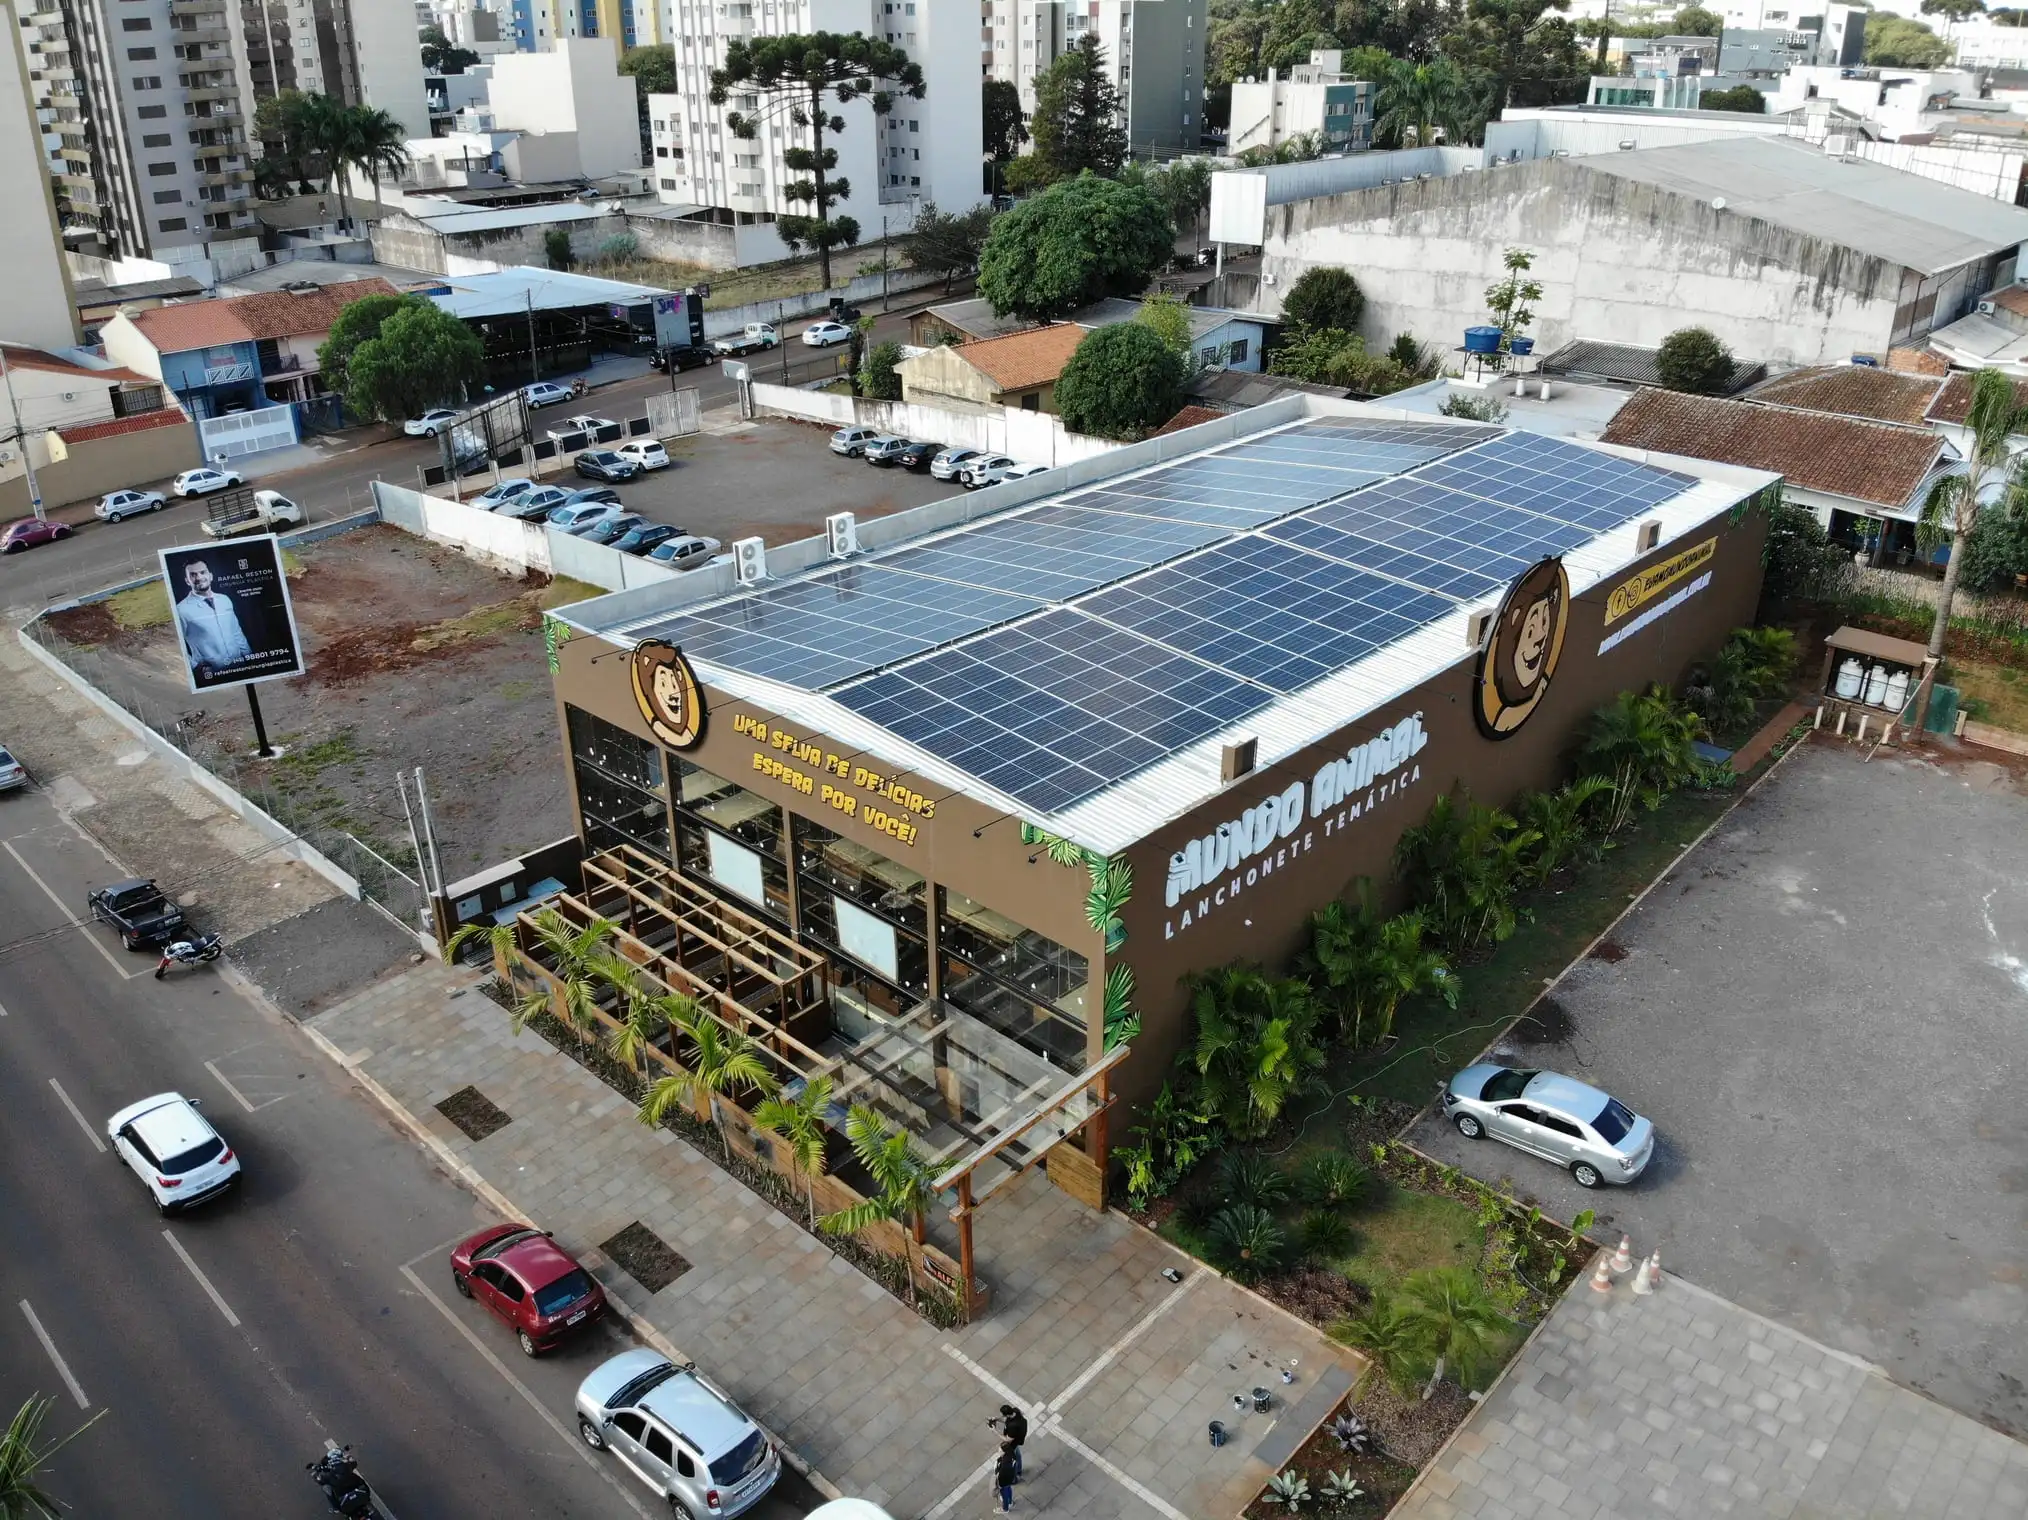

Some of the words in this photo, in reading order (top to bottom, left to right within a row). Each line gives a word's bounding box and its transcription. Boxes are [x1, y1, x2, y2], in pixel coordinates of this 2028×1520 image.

[217, 574, 244, 582] RAFAEL
[245, 568, 273, 578] RESTON
[734, 714, 768, 743] UMA
[771, 730, 823, 768] SELVA
[825, 754, 850, 779] DE
[853, 766, 936, 819] DELÍCIAS
[752, 752, 814, 796] ESPERA
[820, 784, 857, 817] POR
[863, 806, 919, 847] VOCÊ!
[1165, 781, 1305, 908] MUNDO
[1310, 710, 1428, 819] ANIMAL
[1164, 831, 1313, 940] LANCHONETE
[1324, 764, 1421, 837] TEMÁTICA
